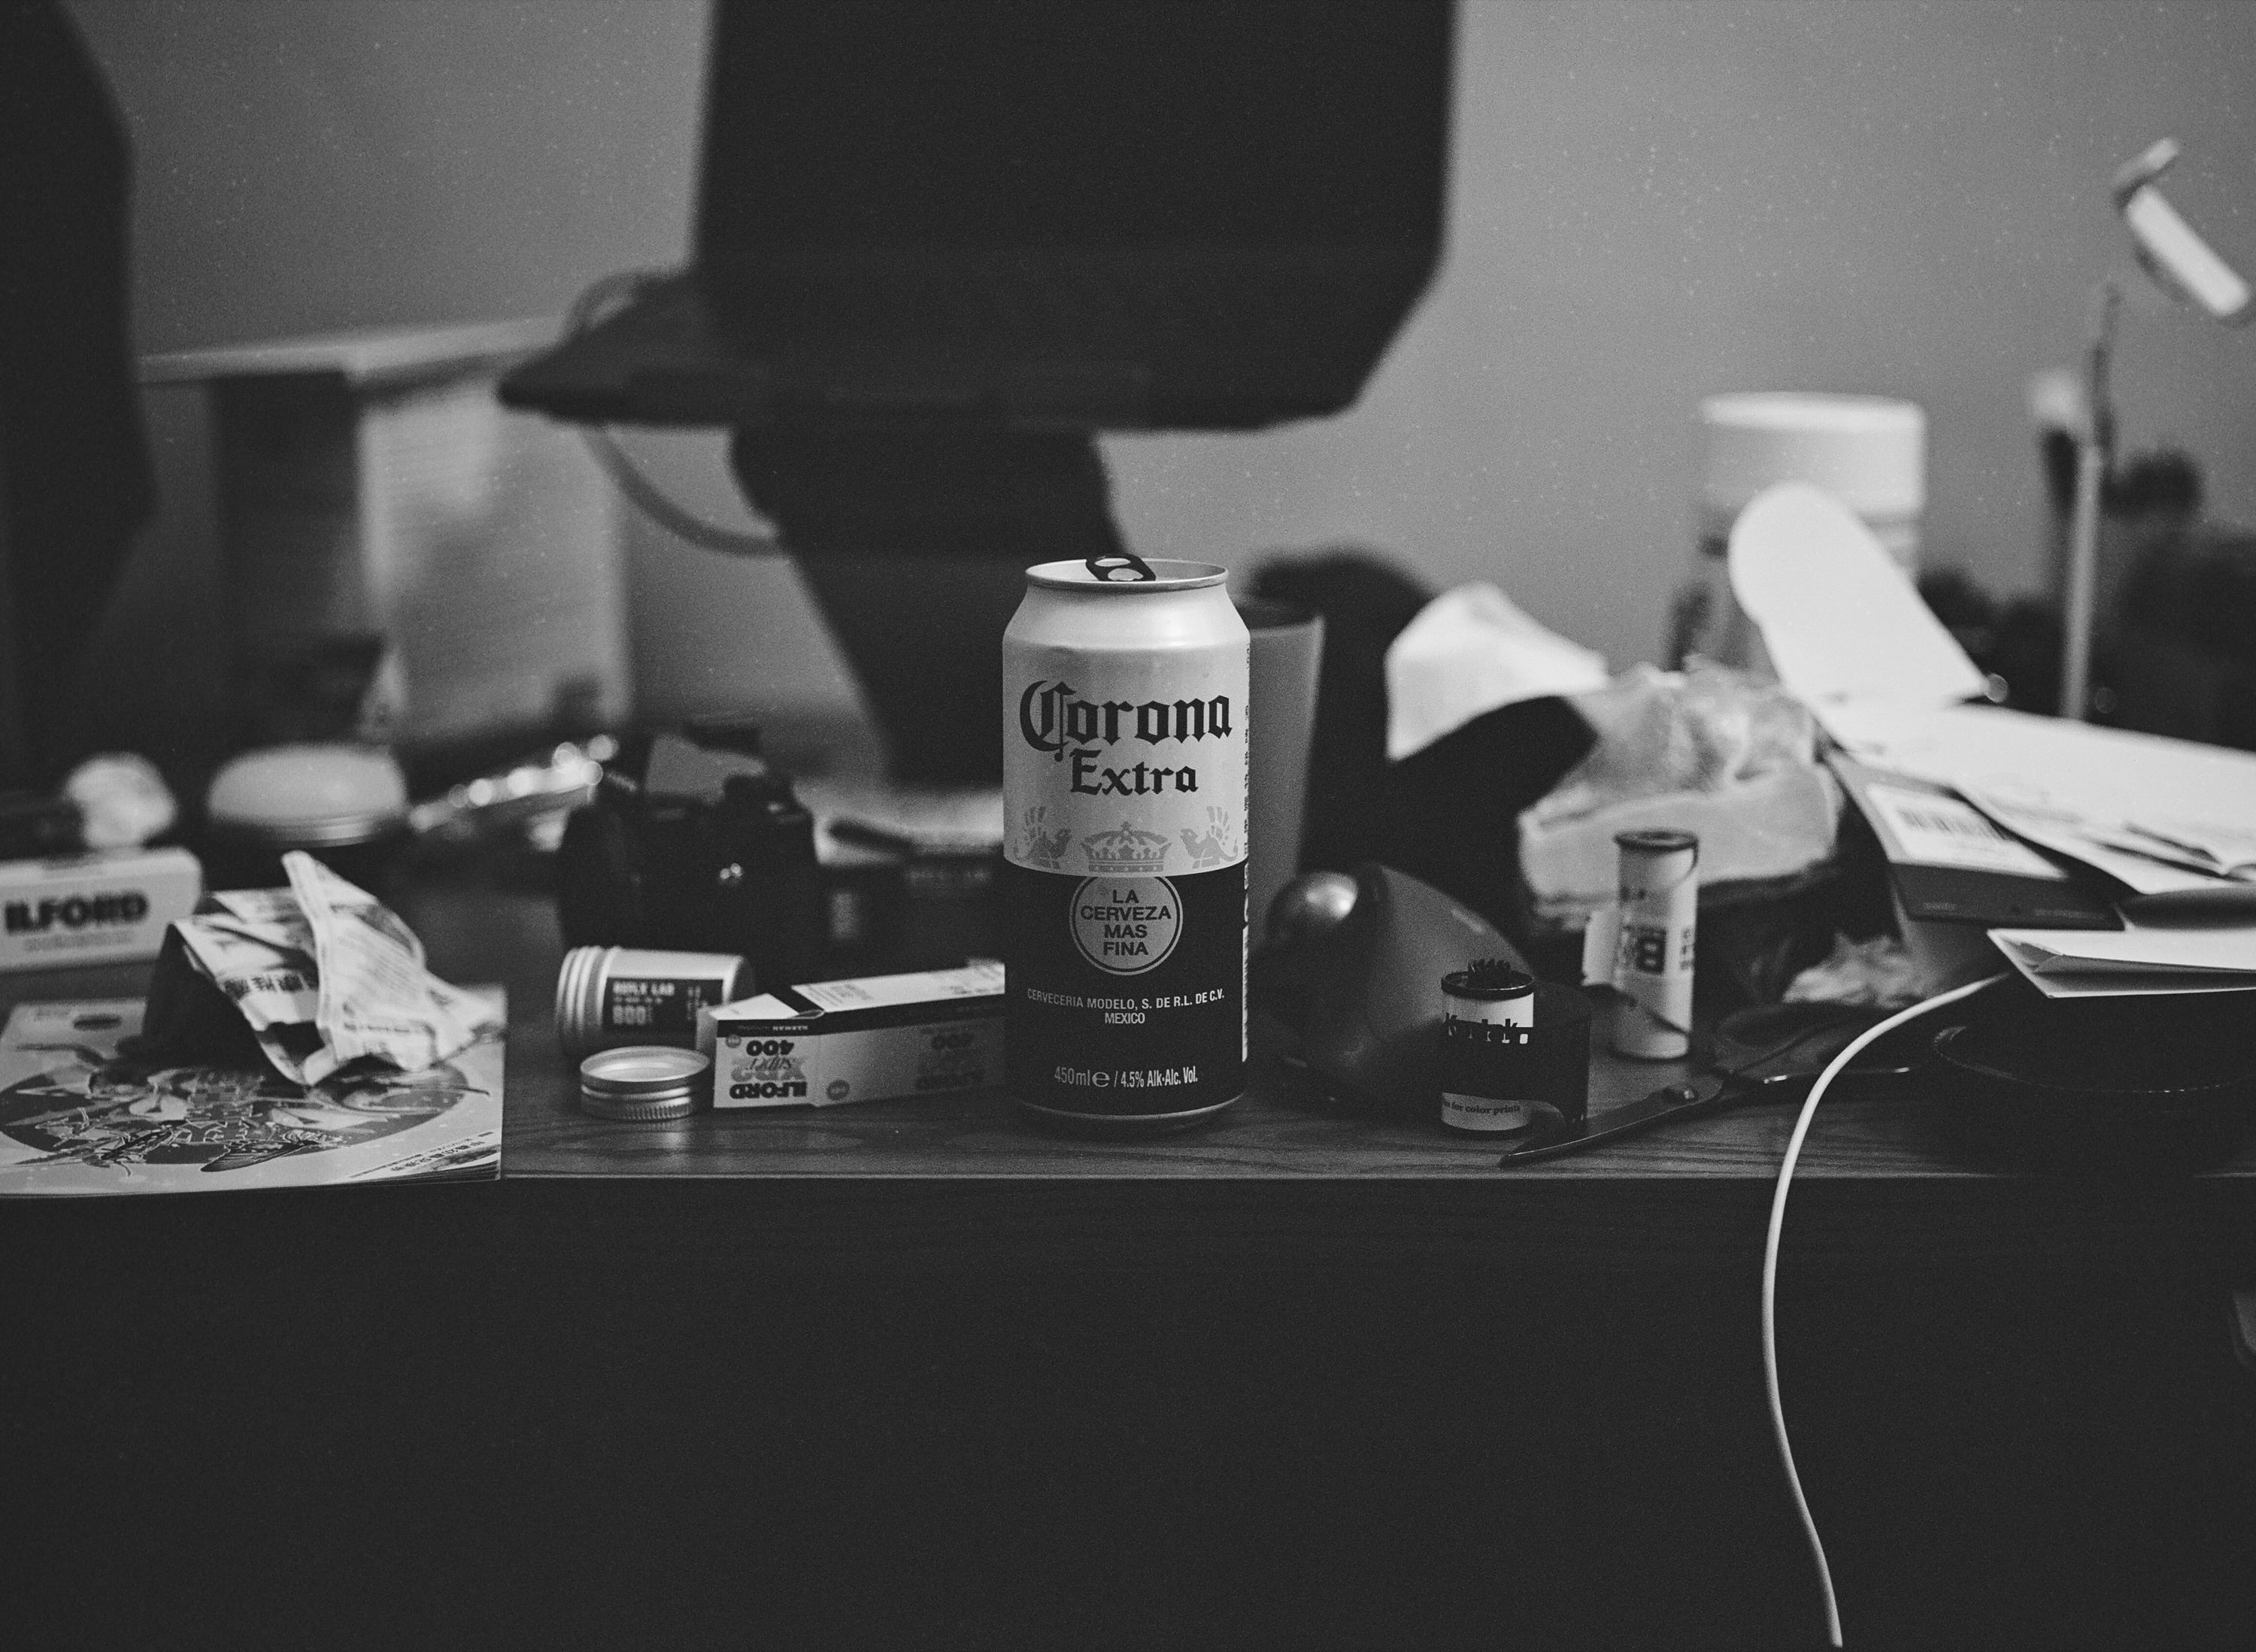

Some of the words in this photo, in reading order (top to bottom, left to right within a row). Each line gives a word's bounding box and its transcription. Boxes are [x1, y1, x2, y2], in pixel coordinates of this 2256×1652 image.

[1020, 681, 1233, 762] Corona
[1069, 748, 1199, 795] Extra
[1112, 890, 1139, 904] LA
[1081, 905, 1171, 922] CERVEZA
[1104, 924, 1148, 938] MAS
[1103, 942, 1148, 956] FINA
[1027, 988, 1083, 1008] CERVECERIA
[1087, 998, 1138, 1011] MODELO,
[1142, 999, 1152, 1009] S.
[1156, 998, 1170, 1008] DE
[1173, 996, 1193, 1007] R.L.
[1195, 992, 1208, 1005] DE
[1209, 988, 1225, 1001] C.V.
[1105, 1012, 1145, 1024] MEXICO
[745, 1040, 795, 1057] 400
[1120, 1071, 1145, 1088] 4.5%
[1183, 1065, 1198, 1084] Vol.
[729, 1081, 808, 1099] ILFORD
[1466, 1105, 1491, 1114] color
